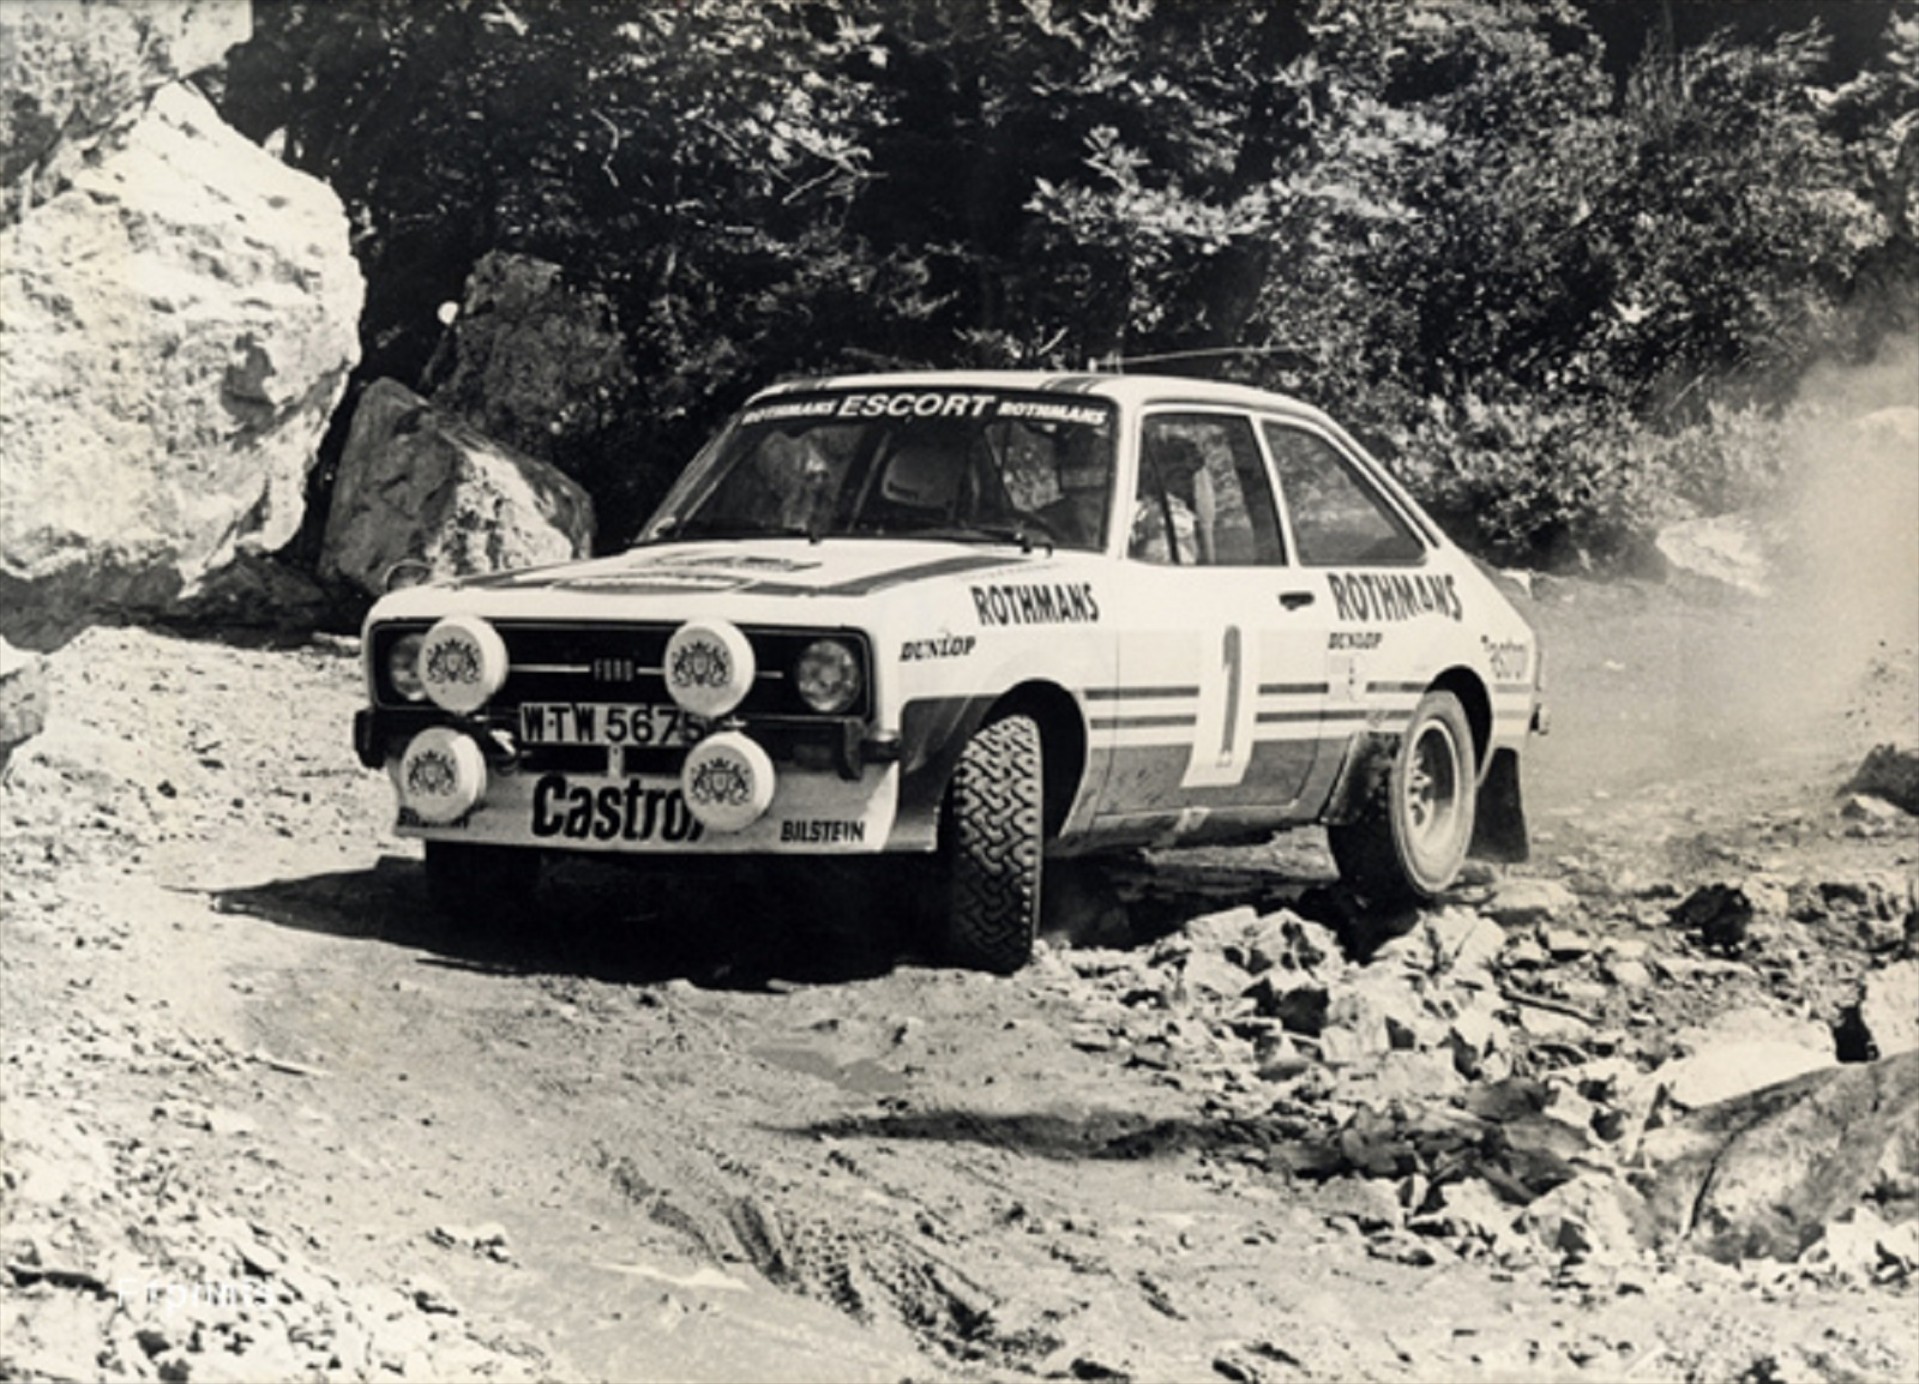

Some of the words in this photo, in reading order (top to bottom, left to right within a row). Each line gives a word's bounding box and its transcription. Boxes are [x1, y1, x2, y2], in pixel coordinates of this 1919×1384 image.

[837, 393, 996, 417] ESCORT
[997, 402, 1107, 426] ROTHMANS
[971, 583, 1099, 626] ROTHMANS
[1327, 573, 1462, 622] ROTHMANS
[899, 634, 976, 661] DUNLOP
[531, 774, 704, 842] Castro
[781, 820, 865, 842] BILSTEIN
